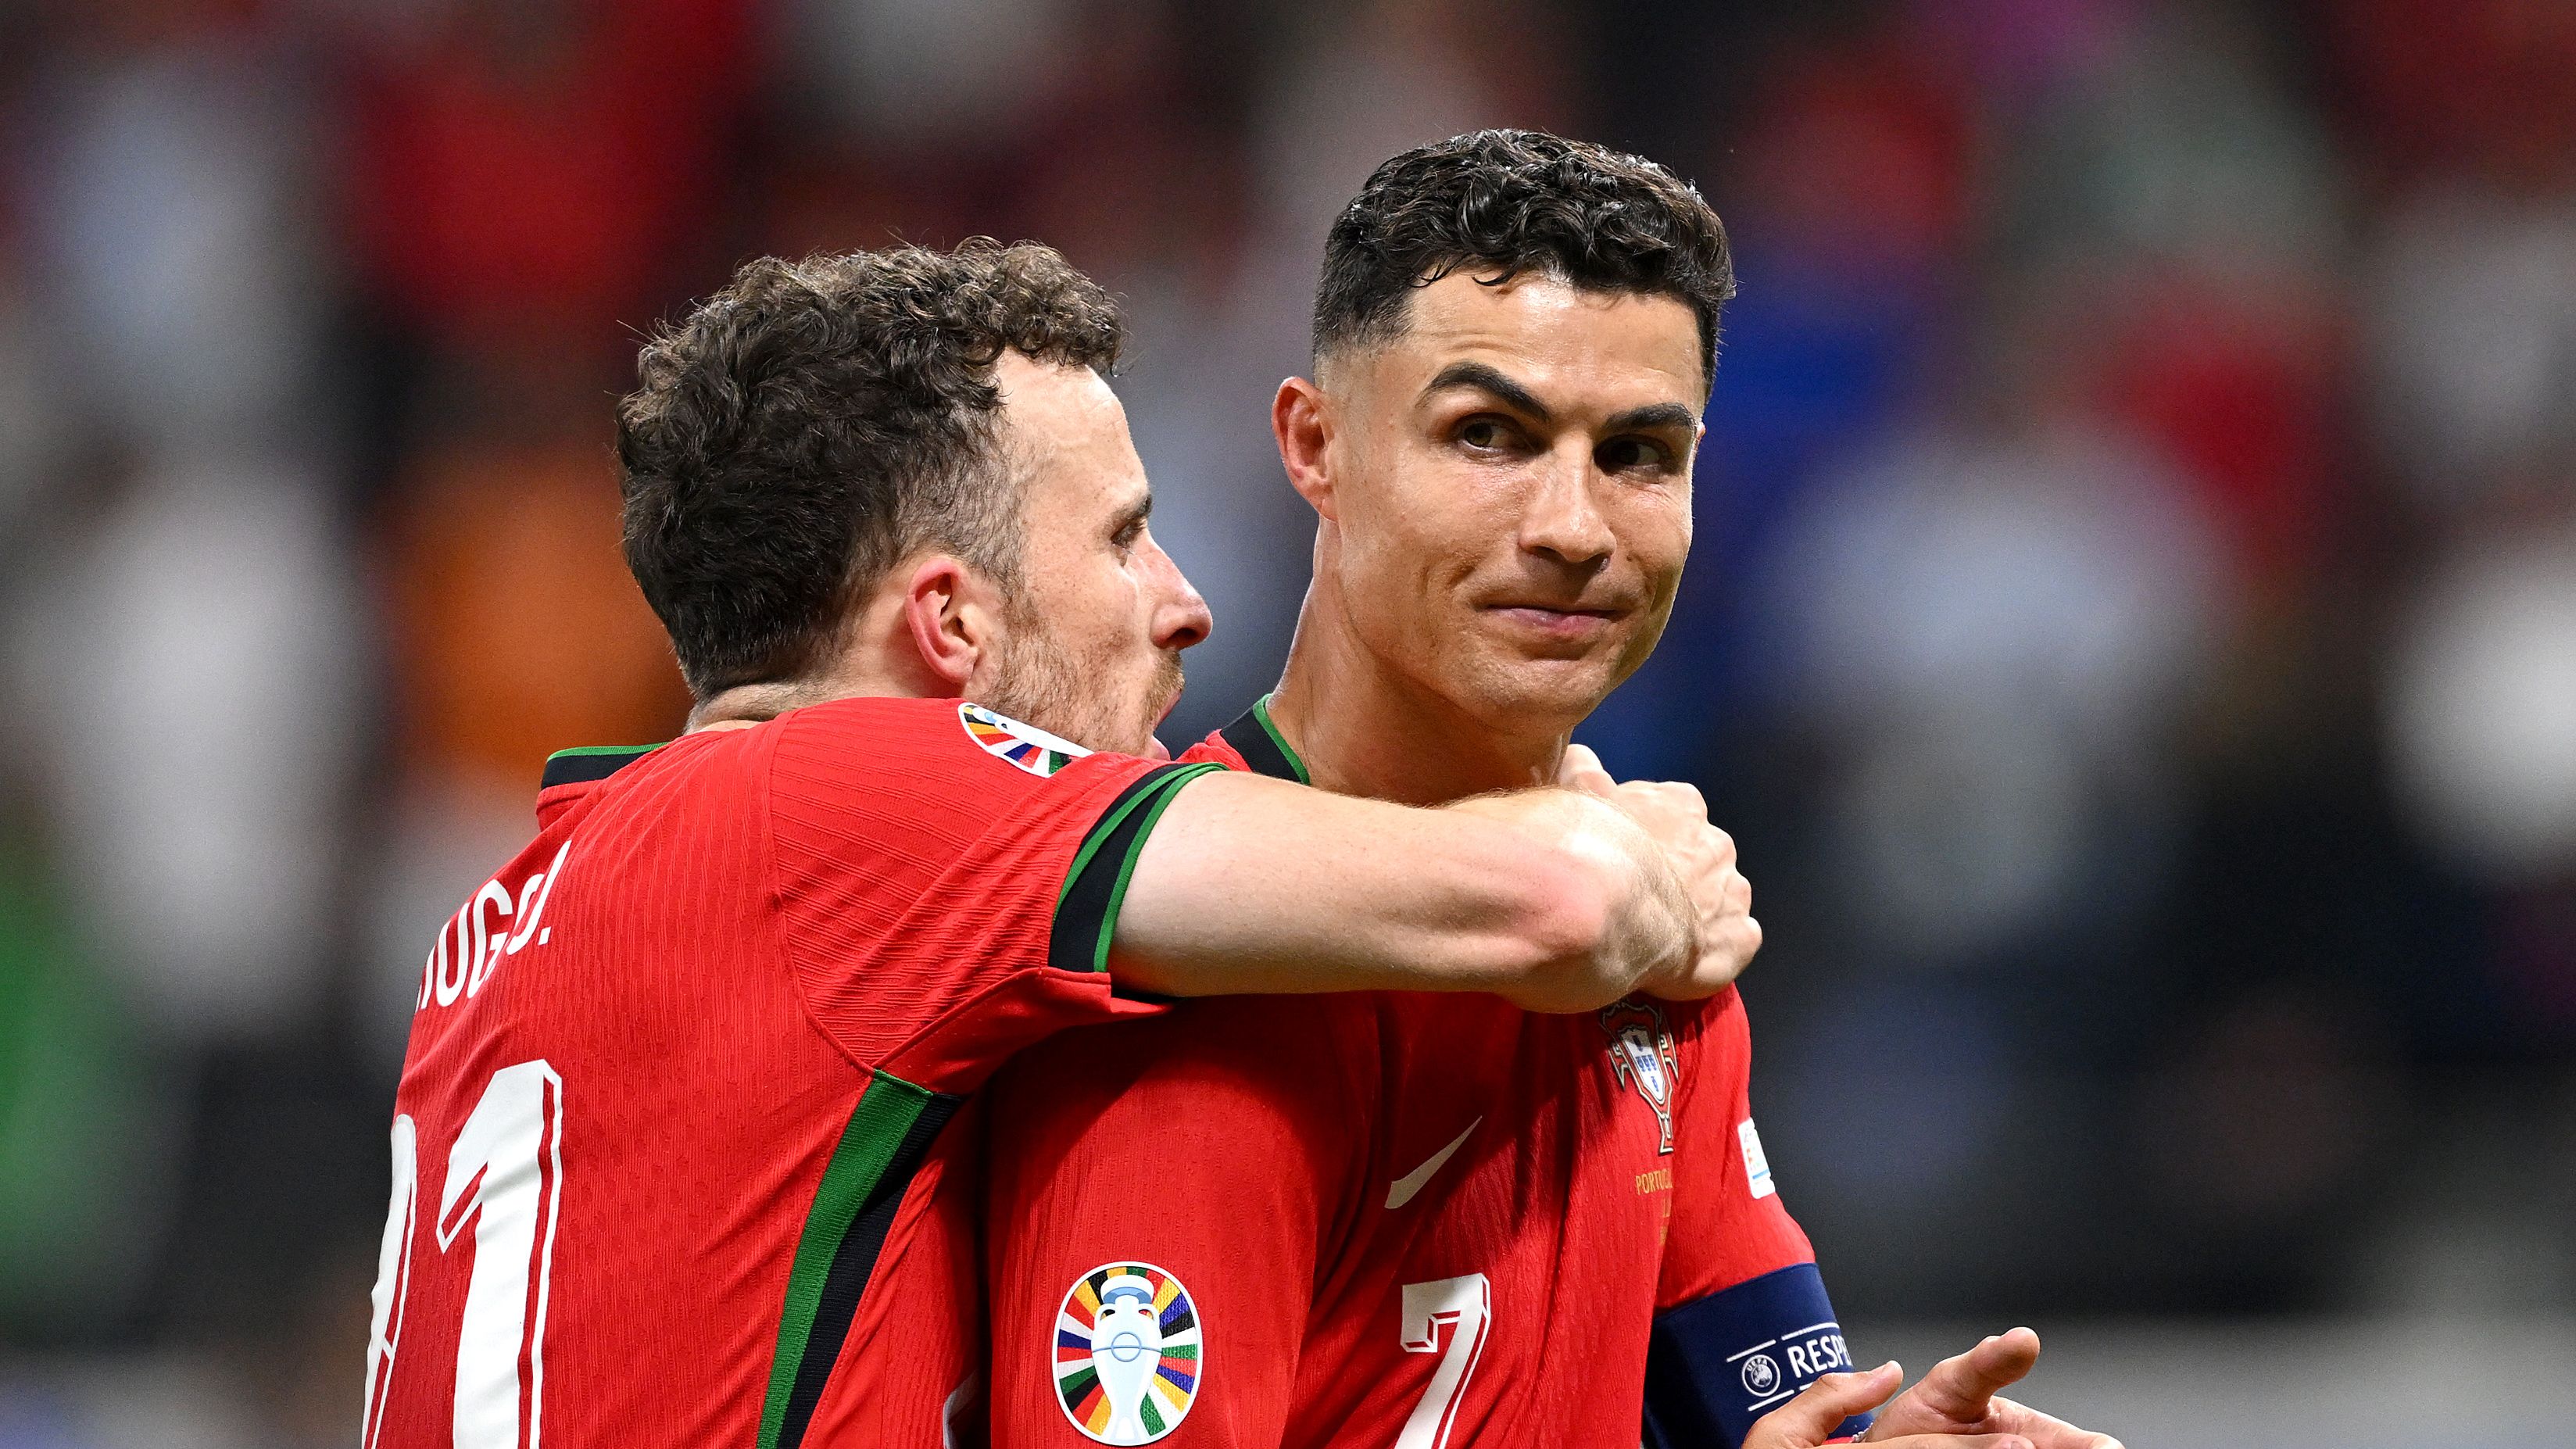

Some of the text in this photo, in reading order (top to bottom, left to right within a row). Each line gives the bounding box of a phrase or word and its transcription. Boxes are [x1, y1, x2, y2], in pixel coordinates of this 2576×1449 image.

[1395, 1272, 1490, 1449] 7
[1747, 1335, 1853, 1378] UEFA RESPE
